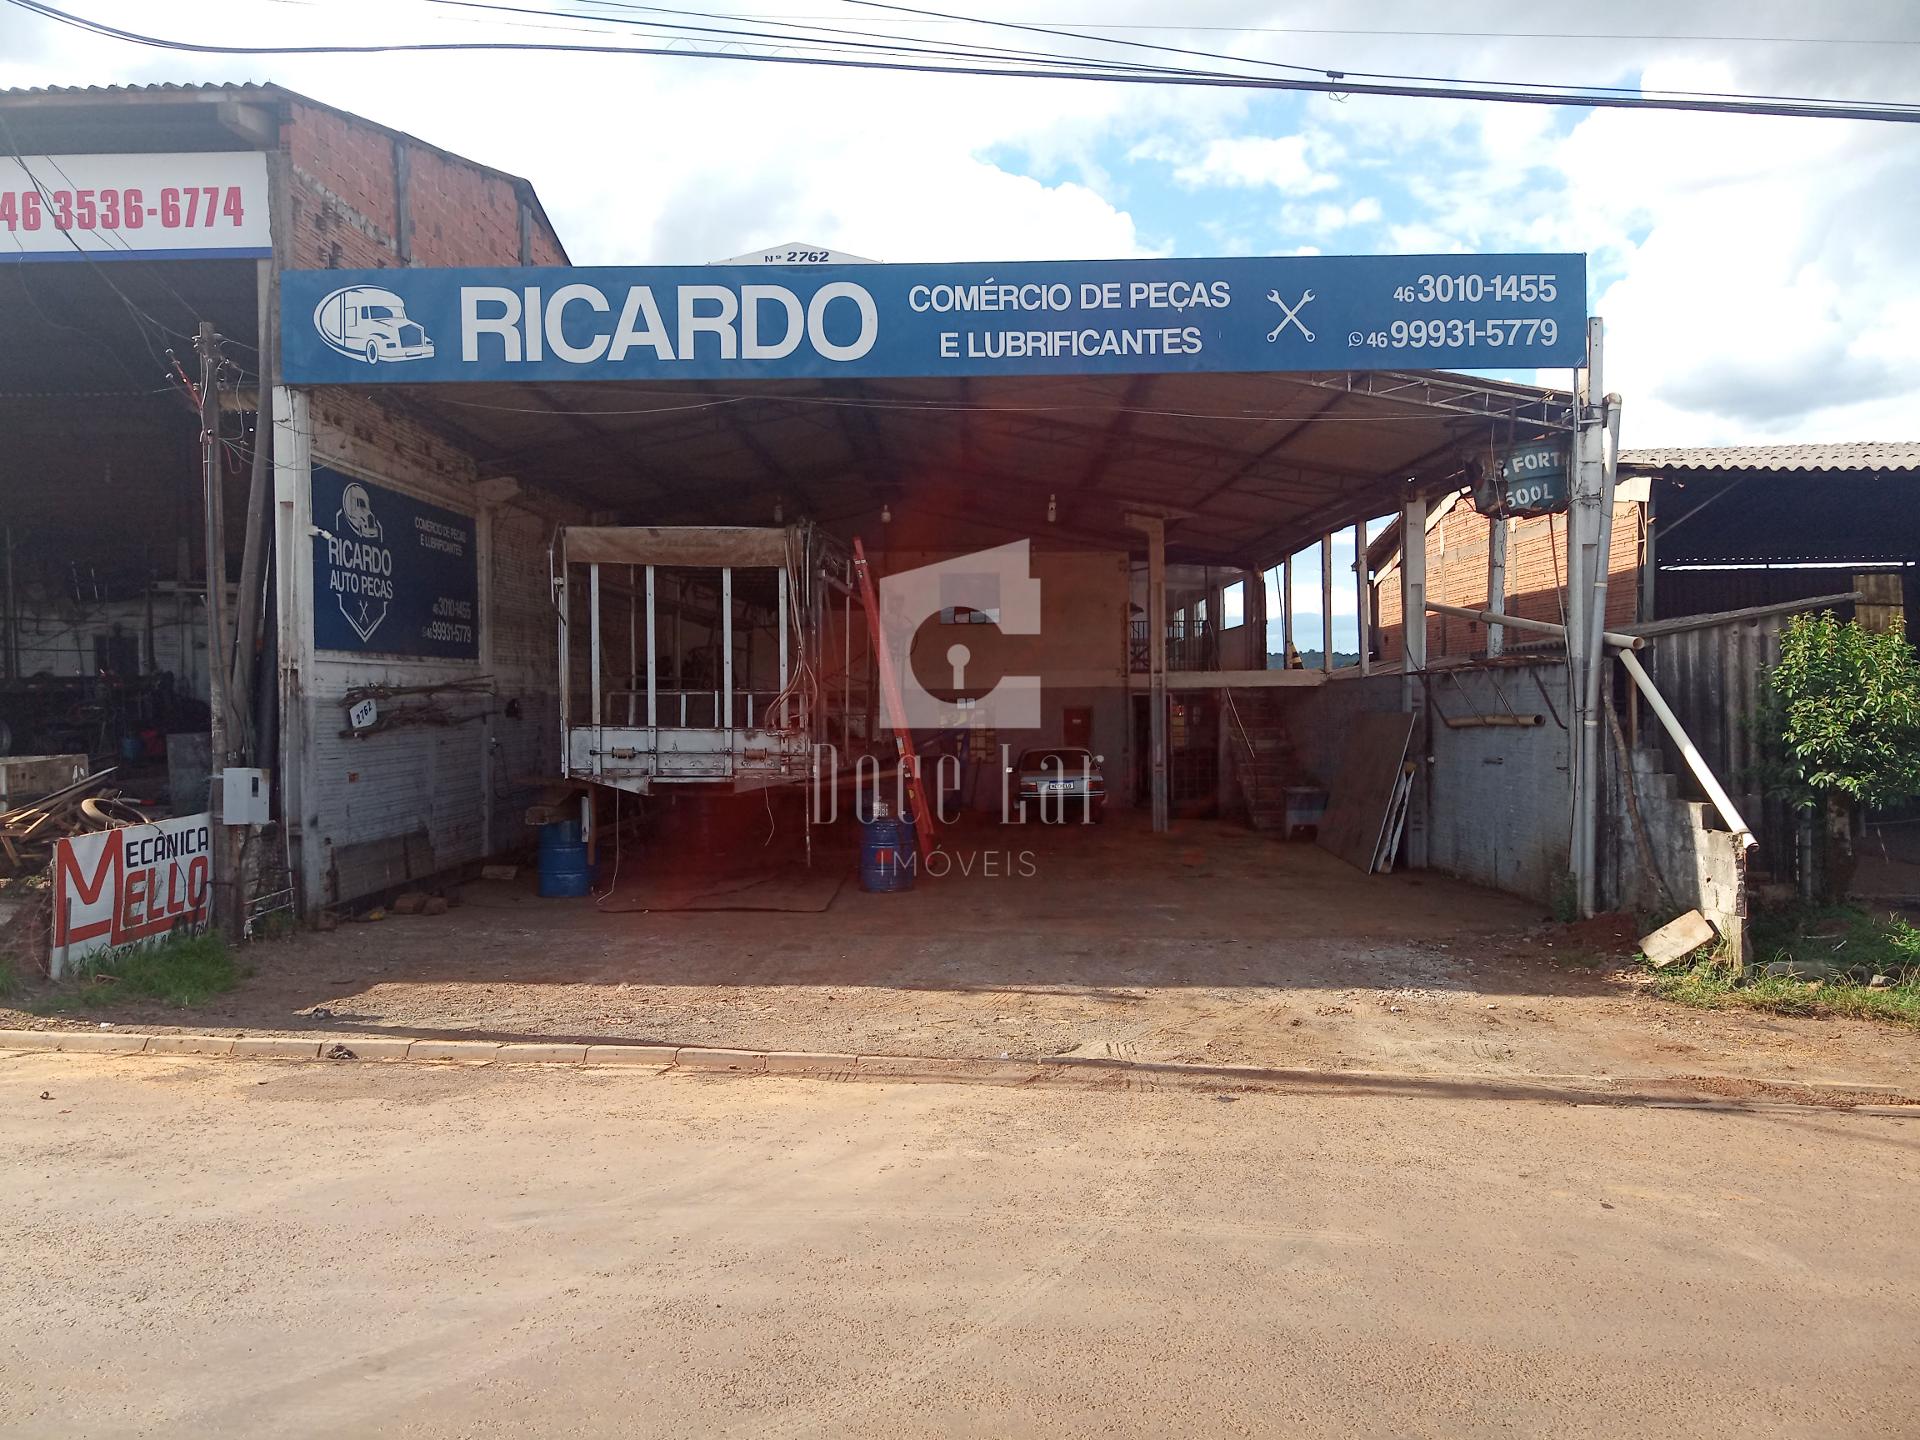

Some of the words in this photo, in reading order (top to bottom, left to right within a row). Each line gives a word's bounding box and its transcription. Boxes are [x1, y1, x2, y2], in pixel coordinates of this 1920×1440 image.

[0, 191, 41, 231] 46
[54, 186, 244, 230] 3536-6774
[787, 251, 830, 263] 2762
[908, 277, 1072, 313] COMÉRCIO
[1080, 284, 1122, 310] DE
[1129, 281, 1231, 313] PEÇAS
[1393, 285, 1415, 303] 46
[1417, 274, 1557, 302] 3010-1455
[460, 281, 878, 364] RICARDO
[1366, 331, 1388, 348] 46
[1390, 318, 1558, 348] 99931-5779
[939, 332, 960, 358] E
[967, 327, 1203, 358] LUBRIFICANTES
[328, 537, 392, 577] RICARDO
[329, 569, 359, 593] AUTO
[356, 701, 372, 724] 2762
